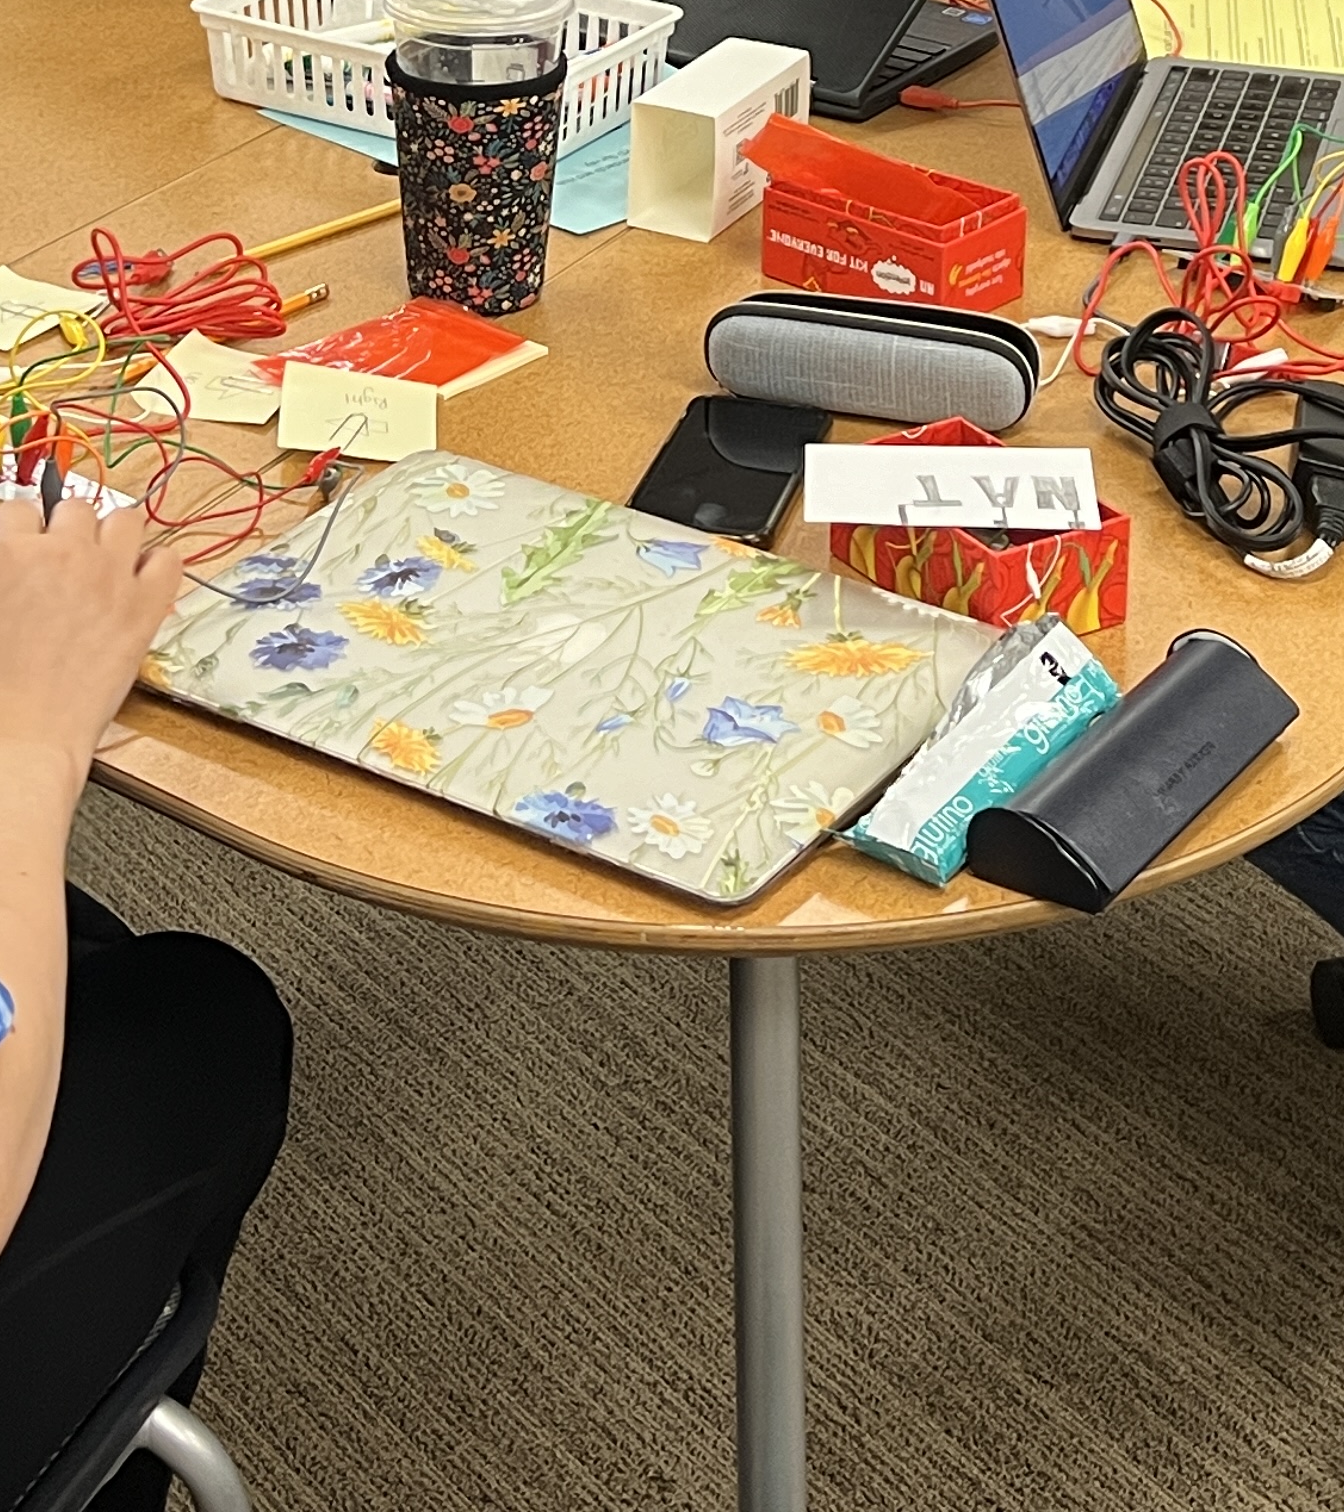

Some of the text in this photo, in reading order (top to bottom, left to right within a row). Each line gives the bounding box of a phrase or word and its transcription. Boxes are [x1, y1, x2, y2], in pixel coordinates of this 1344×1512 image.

[825, 248, 848, 267] FOR
[848, 254, 869, 274] KIT
[914, 474, 1082, 512] NAT
